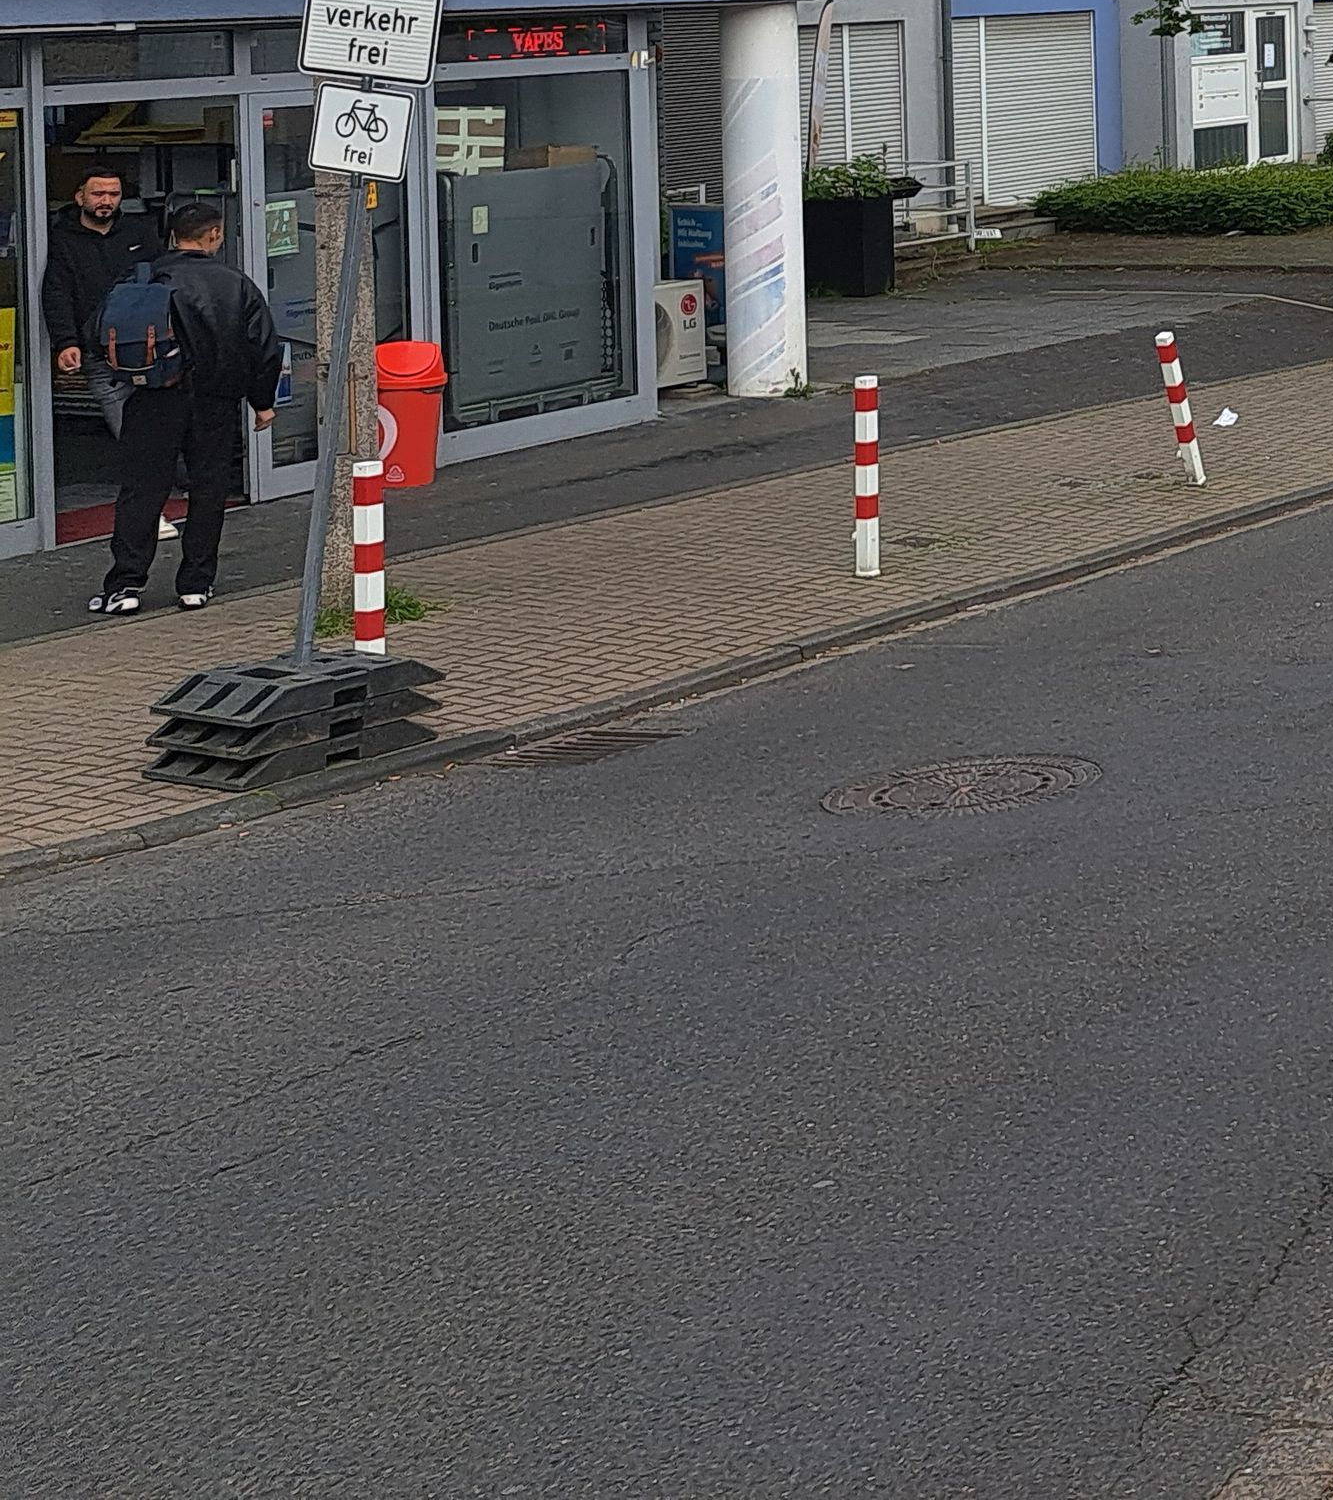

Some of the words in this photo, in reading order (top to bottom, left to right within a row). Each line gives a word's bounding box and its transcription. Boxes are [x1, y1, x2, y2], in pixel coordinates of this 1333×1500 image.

[326, 4, 419, 35] verkehr
[348, 37, 389, 67] frei
[512, 31, 564, 53] VAPES
[343, 143, 373, 166] frei
[683, 317, 697, 332] LG
